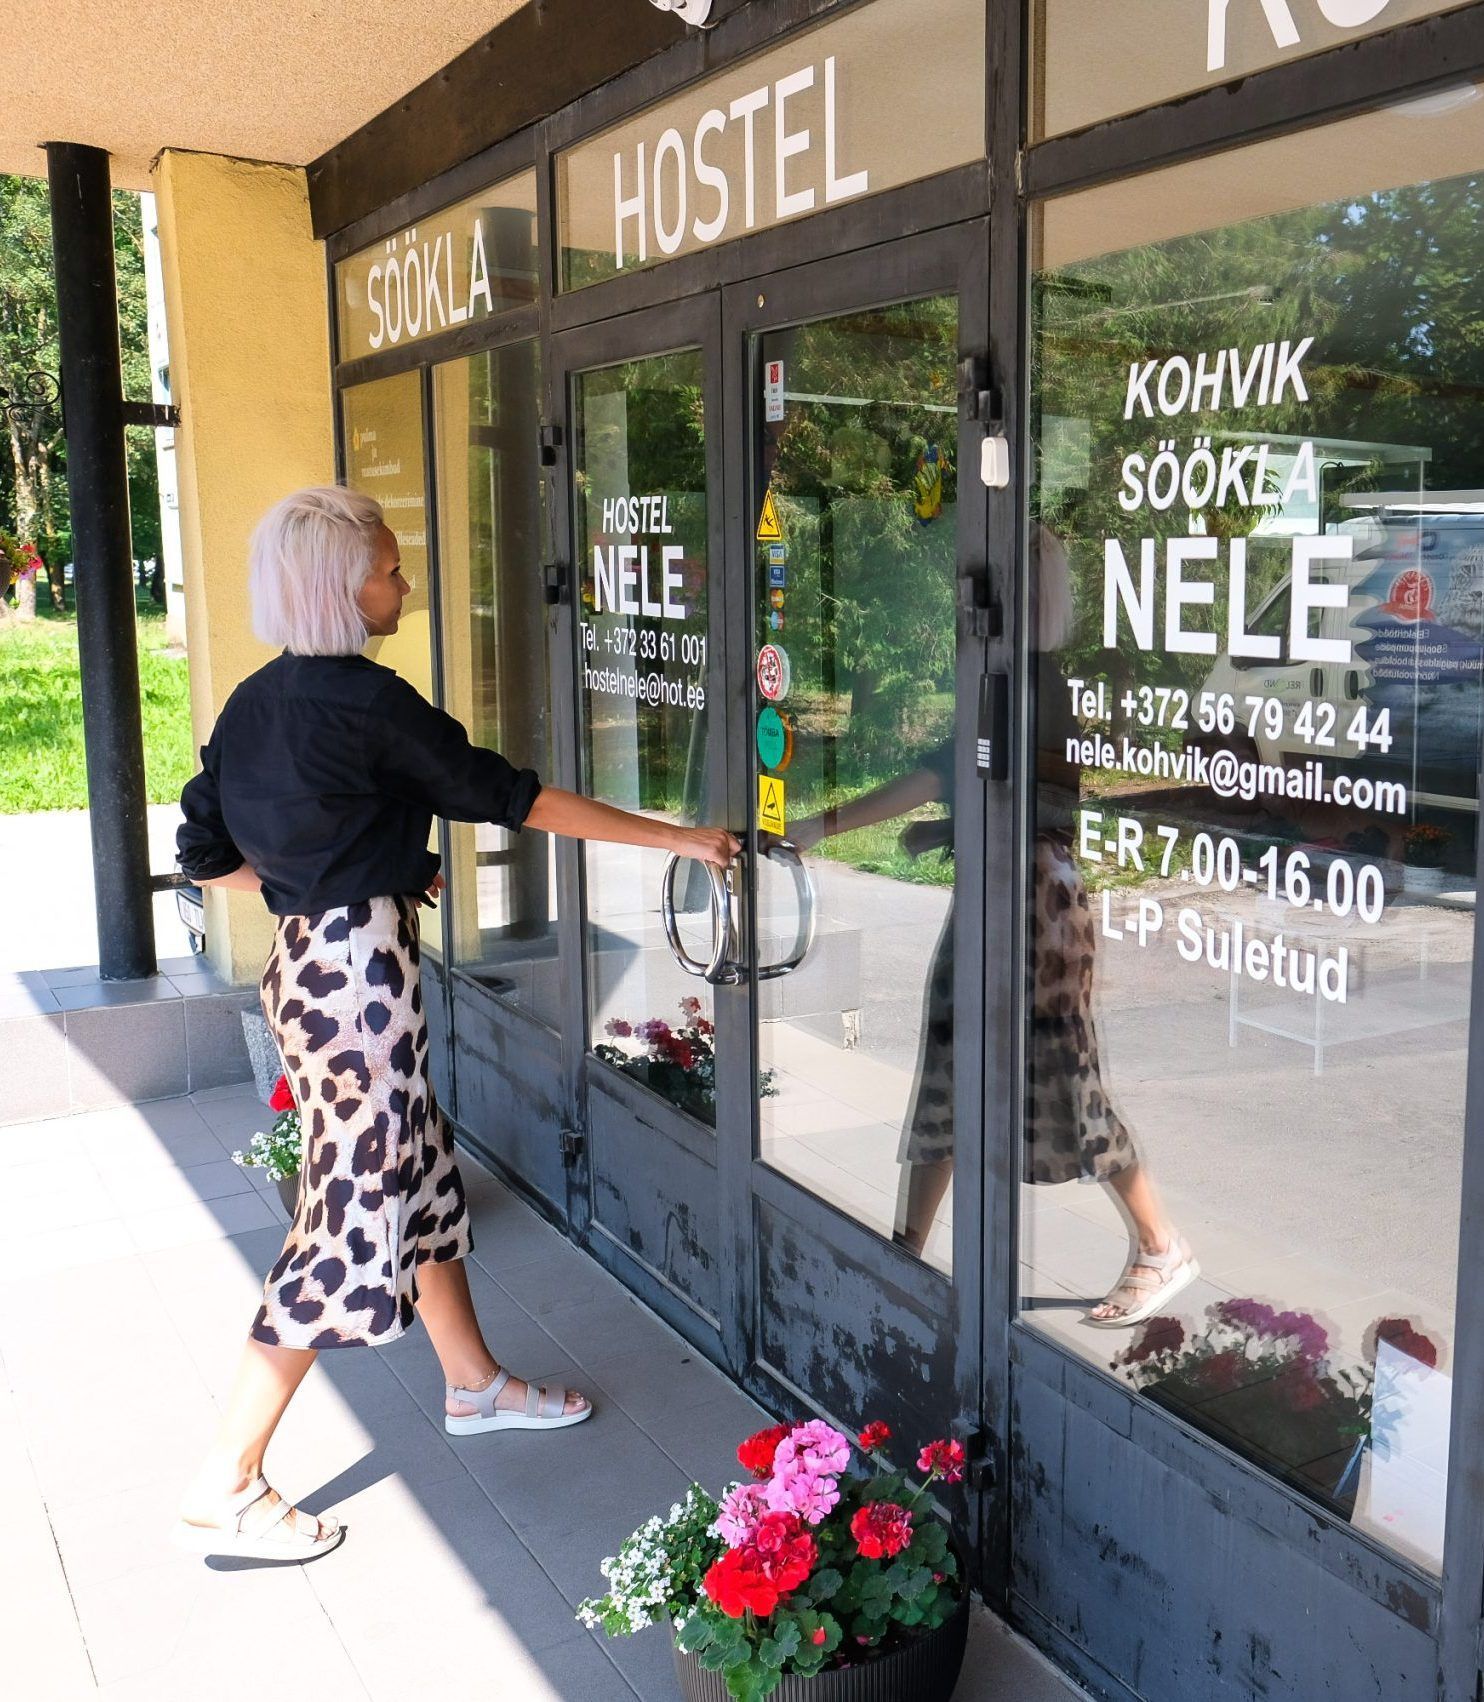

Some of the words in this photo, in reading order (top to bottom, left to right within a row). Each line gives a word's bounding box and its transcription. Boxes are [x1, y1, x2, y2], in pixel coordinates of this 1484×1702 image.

[613, 56, 869, 270] HOSTEL
[367, 218, 494, 350] SÖÖKLA
[1123, 336, 1316, 421] KOHVIK
[1117, 436, 1318, 511] SÖÖKLA
[602, 495, 673, 534] HOSTEL
[593, 545, 686, 620] NELE
[1103, 535, 1354, 664] NELE
[580, 622, 600, 651] Tel.
[604, 626, 637, 657] +372
[640, 630, 657, 660] 33
[660, 632, 676, 662] 61
[681, 634, 706, 665] 001
[584, 662, 706, 711] hostelnele@hot.ee
[1067, 679, 1112, 721] Tel.
[1120, 685, 1189, 730] +372
[1198, 691, 1235, 735] 56
[1244, 695, 1284, 741] 79
[1293, 700, 1337, 747] 42
[1346, 706, 1393, 754] 44
[1065, 735, 1407, 815] nele.kohvik@gmail.com
[1079, 809, 1144, 871] E-R
[1156, 825, 1385, 925] 7.00-16.00
[1101, 889, 1164, 947] L-P
[1176, 908, 1350, 1004] Suletud
